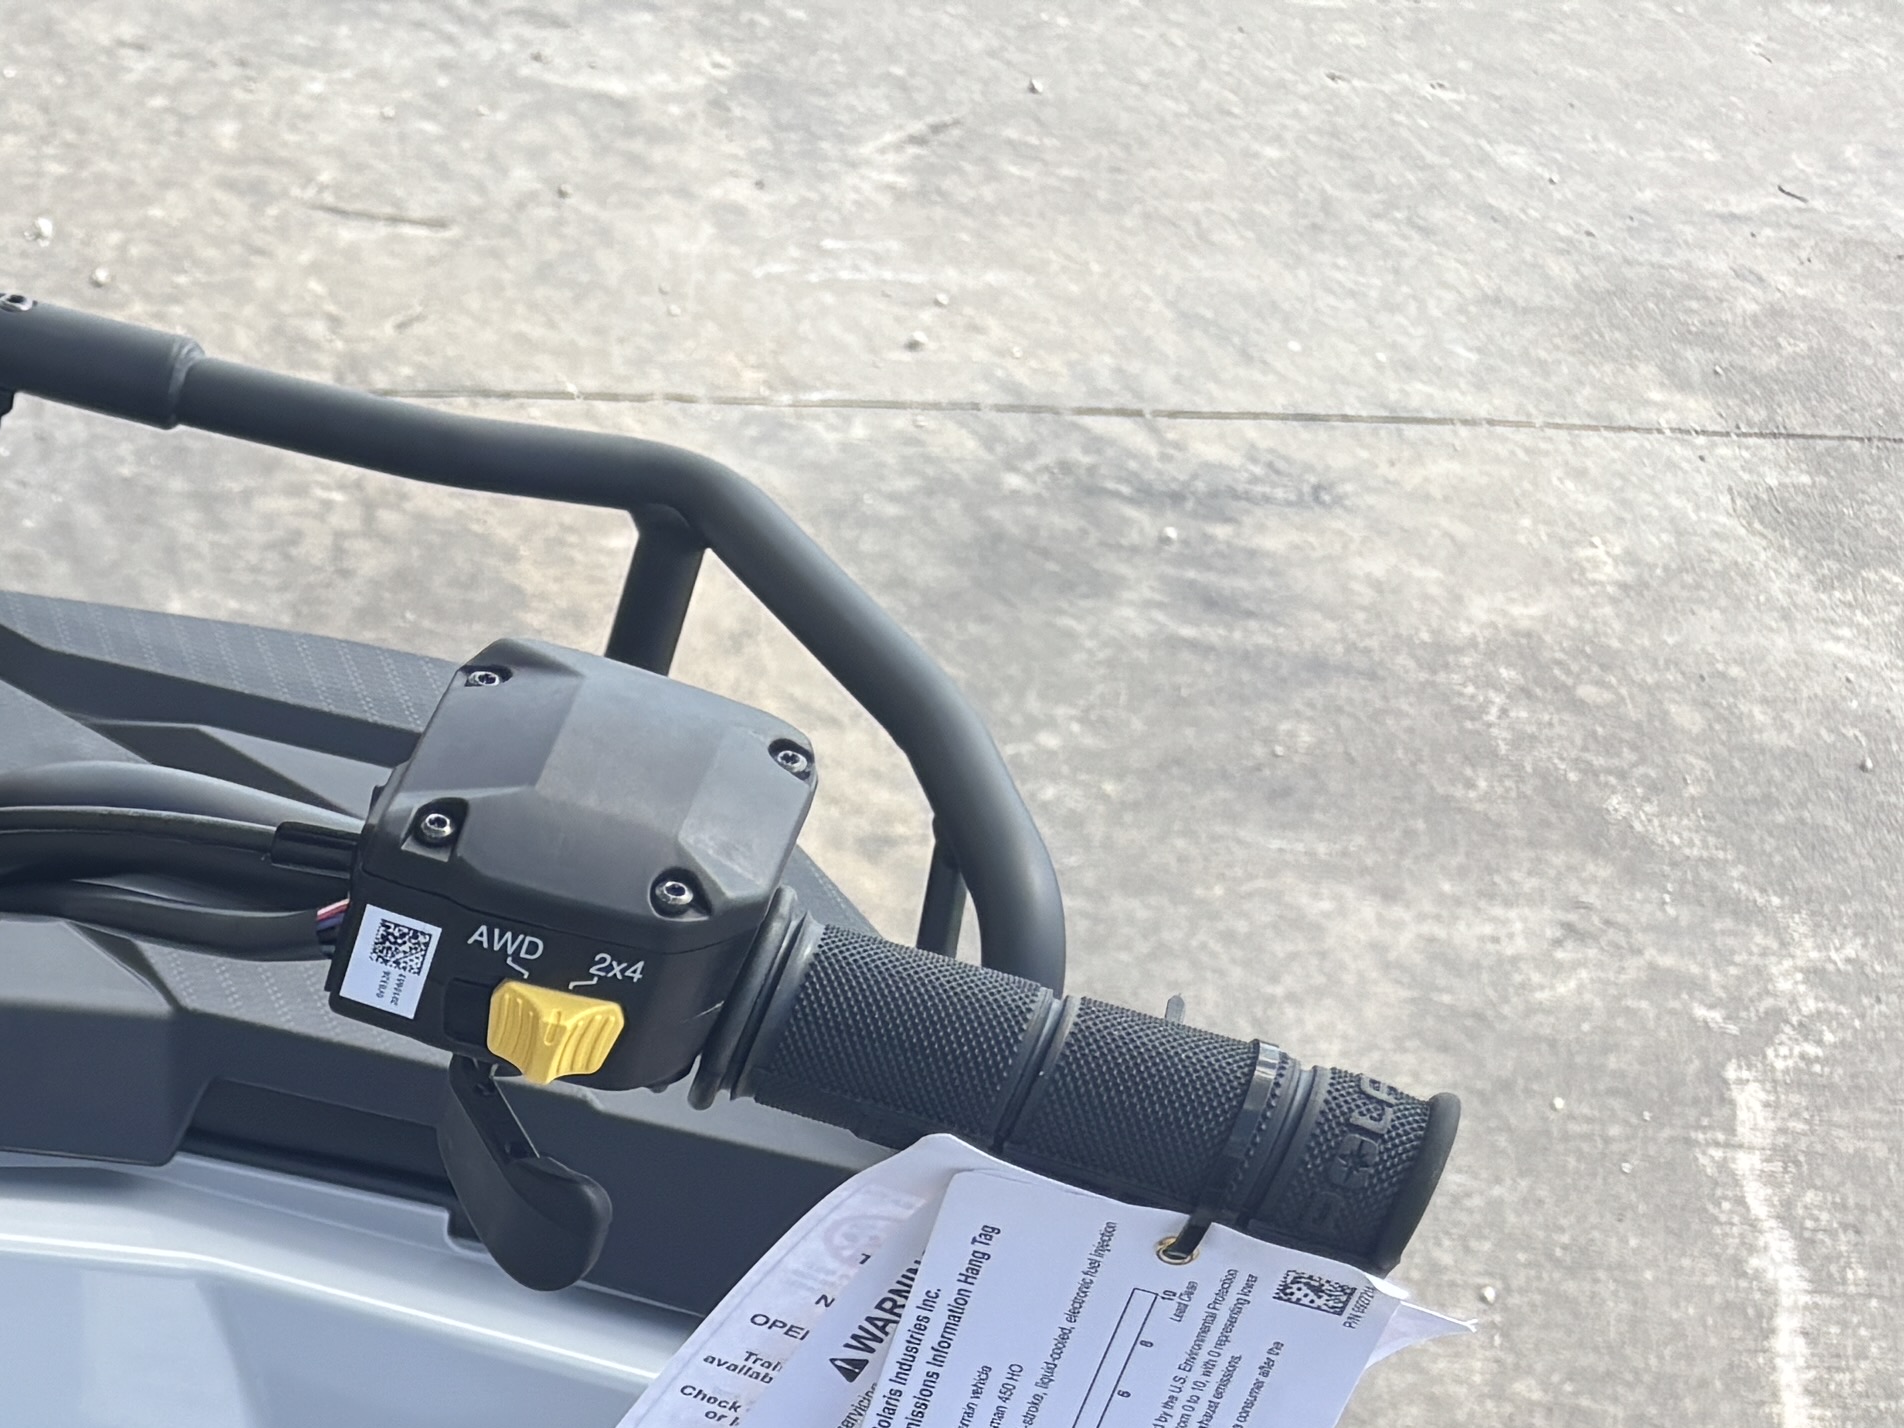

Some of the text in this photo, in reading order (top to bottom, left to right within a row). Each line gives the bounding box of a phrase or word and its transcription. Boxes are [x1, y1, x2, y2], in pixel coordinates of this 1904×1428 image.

[467, 924, 544, 961] AWD
[589, 952, 645, 983] 2x4
[972, 1224, 1001, 1246] Tag
[957, 1249, 991, 1286] Hang
[890, 1314, 931, 1386] Industries
[920, 1288, 942, 1313] Inc.
[925, 1288, 973, 1368] Information
[1118, 1389, 1131, 1399] 6
[1161, 1289, 1176, 1302] 10
